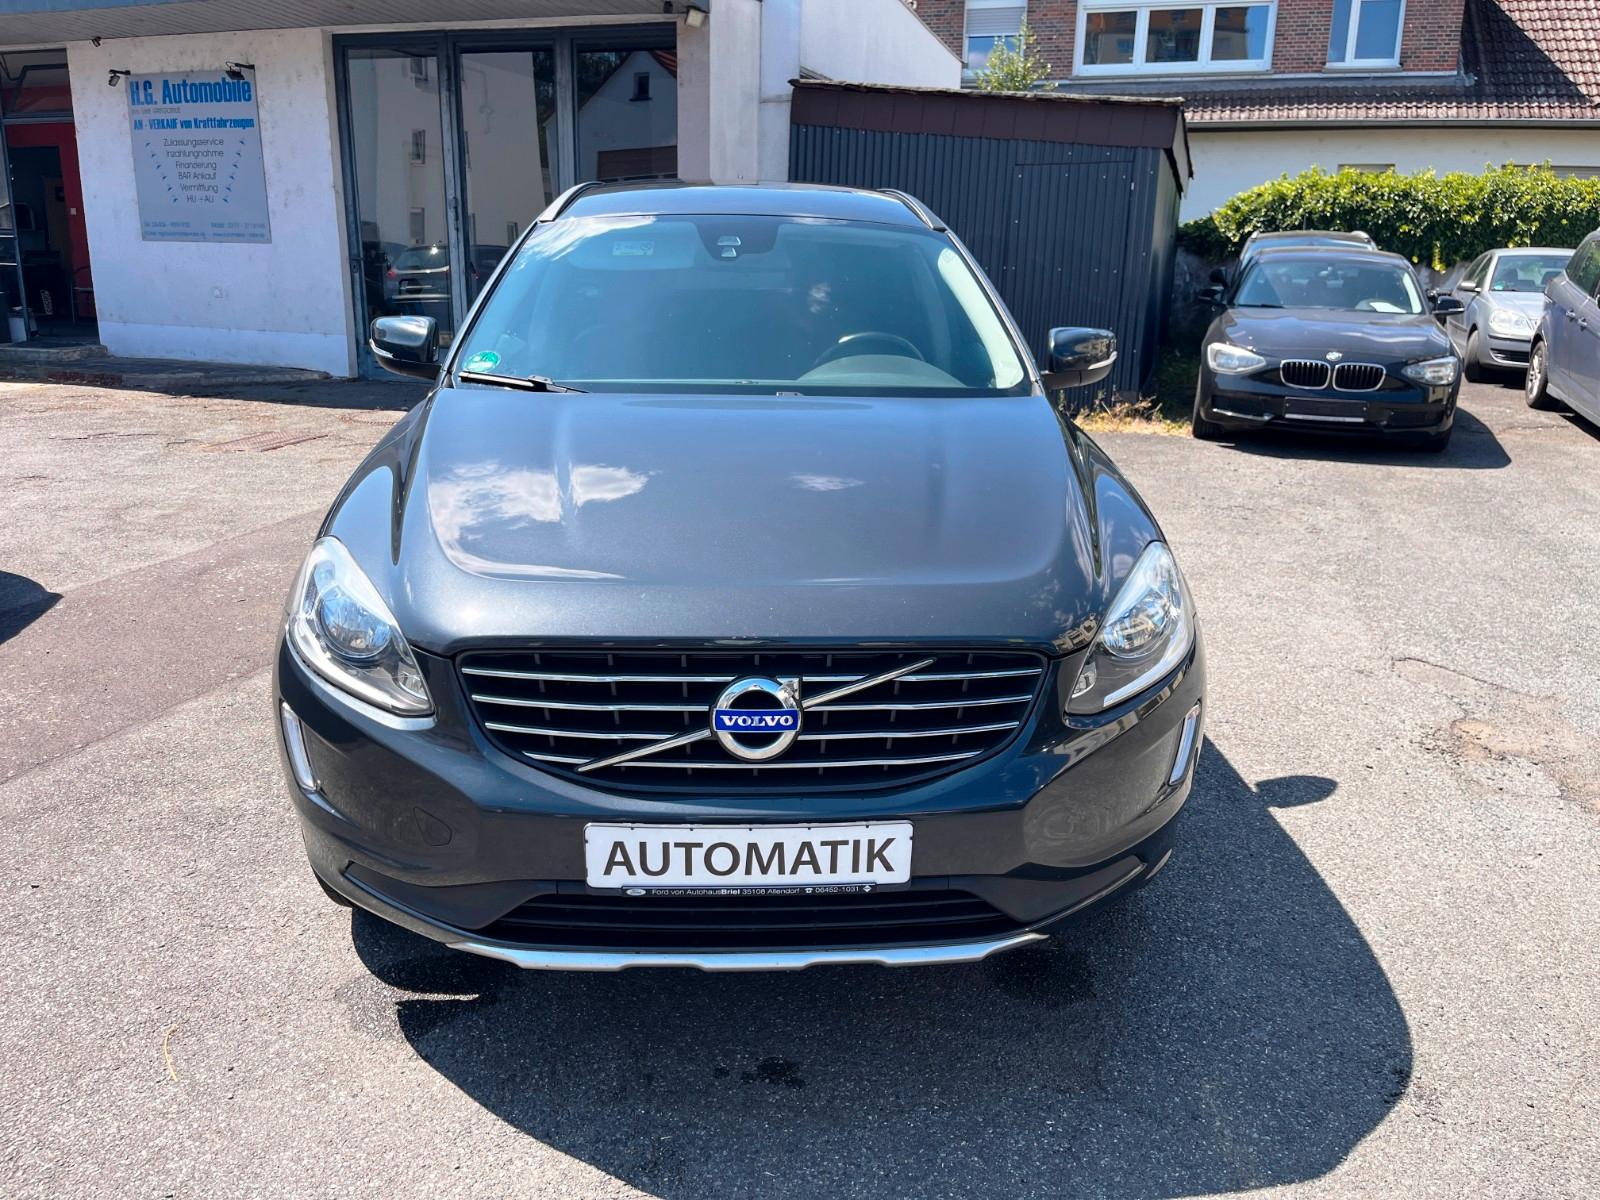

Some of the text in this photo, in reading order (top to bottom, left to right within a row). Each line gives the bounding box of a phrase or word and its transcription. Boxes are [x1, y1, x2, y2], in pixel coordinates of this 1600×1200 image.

[130, 77, 252, 105] H.G. Automobile
[149, 119, 178, 130] VERKAUF
[180, 120, 192, 129] von
[193, 118, 255, 130] Kraftfahrzeugen
[163, 138, 224, 148] Zulassungsservice
[166, 150, 224, 159] Inzahlungnahme
[175, 161, 217, 171] Finanzierung
[178, 172, 217, 180] BAR Ankauf
[180, 184, 219, 194] Vermittlung
[186, 195, 197, 203] HU
[720, 715, 794, 727] VOLVO
[603, 837, 897, 877] AUTOMATIK
[652, 888, 669, 896] Ford
[686, 888, 740, 896] AutohausBriel
[742, 888, 766, 896] 35108
[767, 887, 801, 895] Allendorf
[815, 885, 860, 894] 06452-1031
